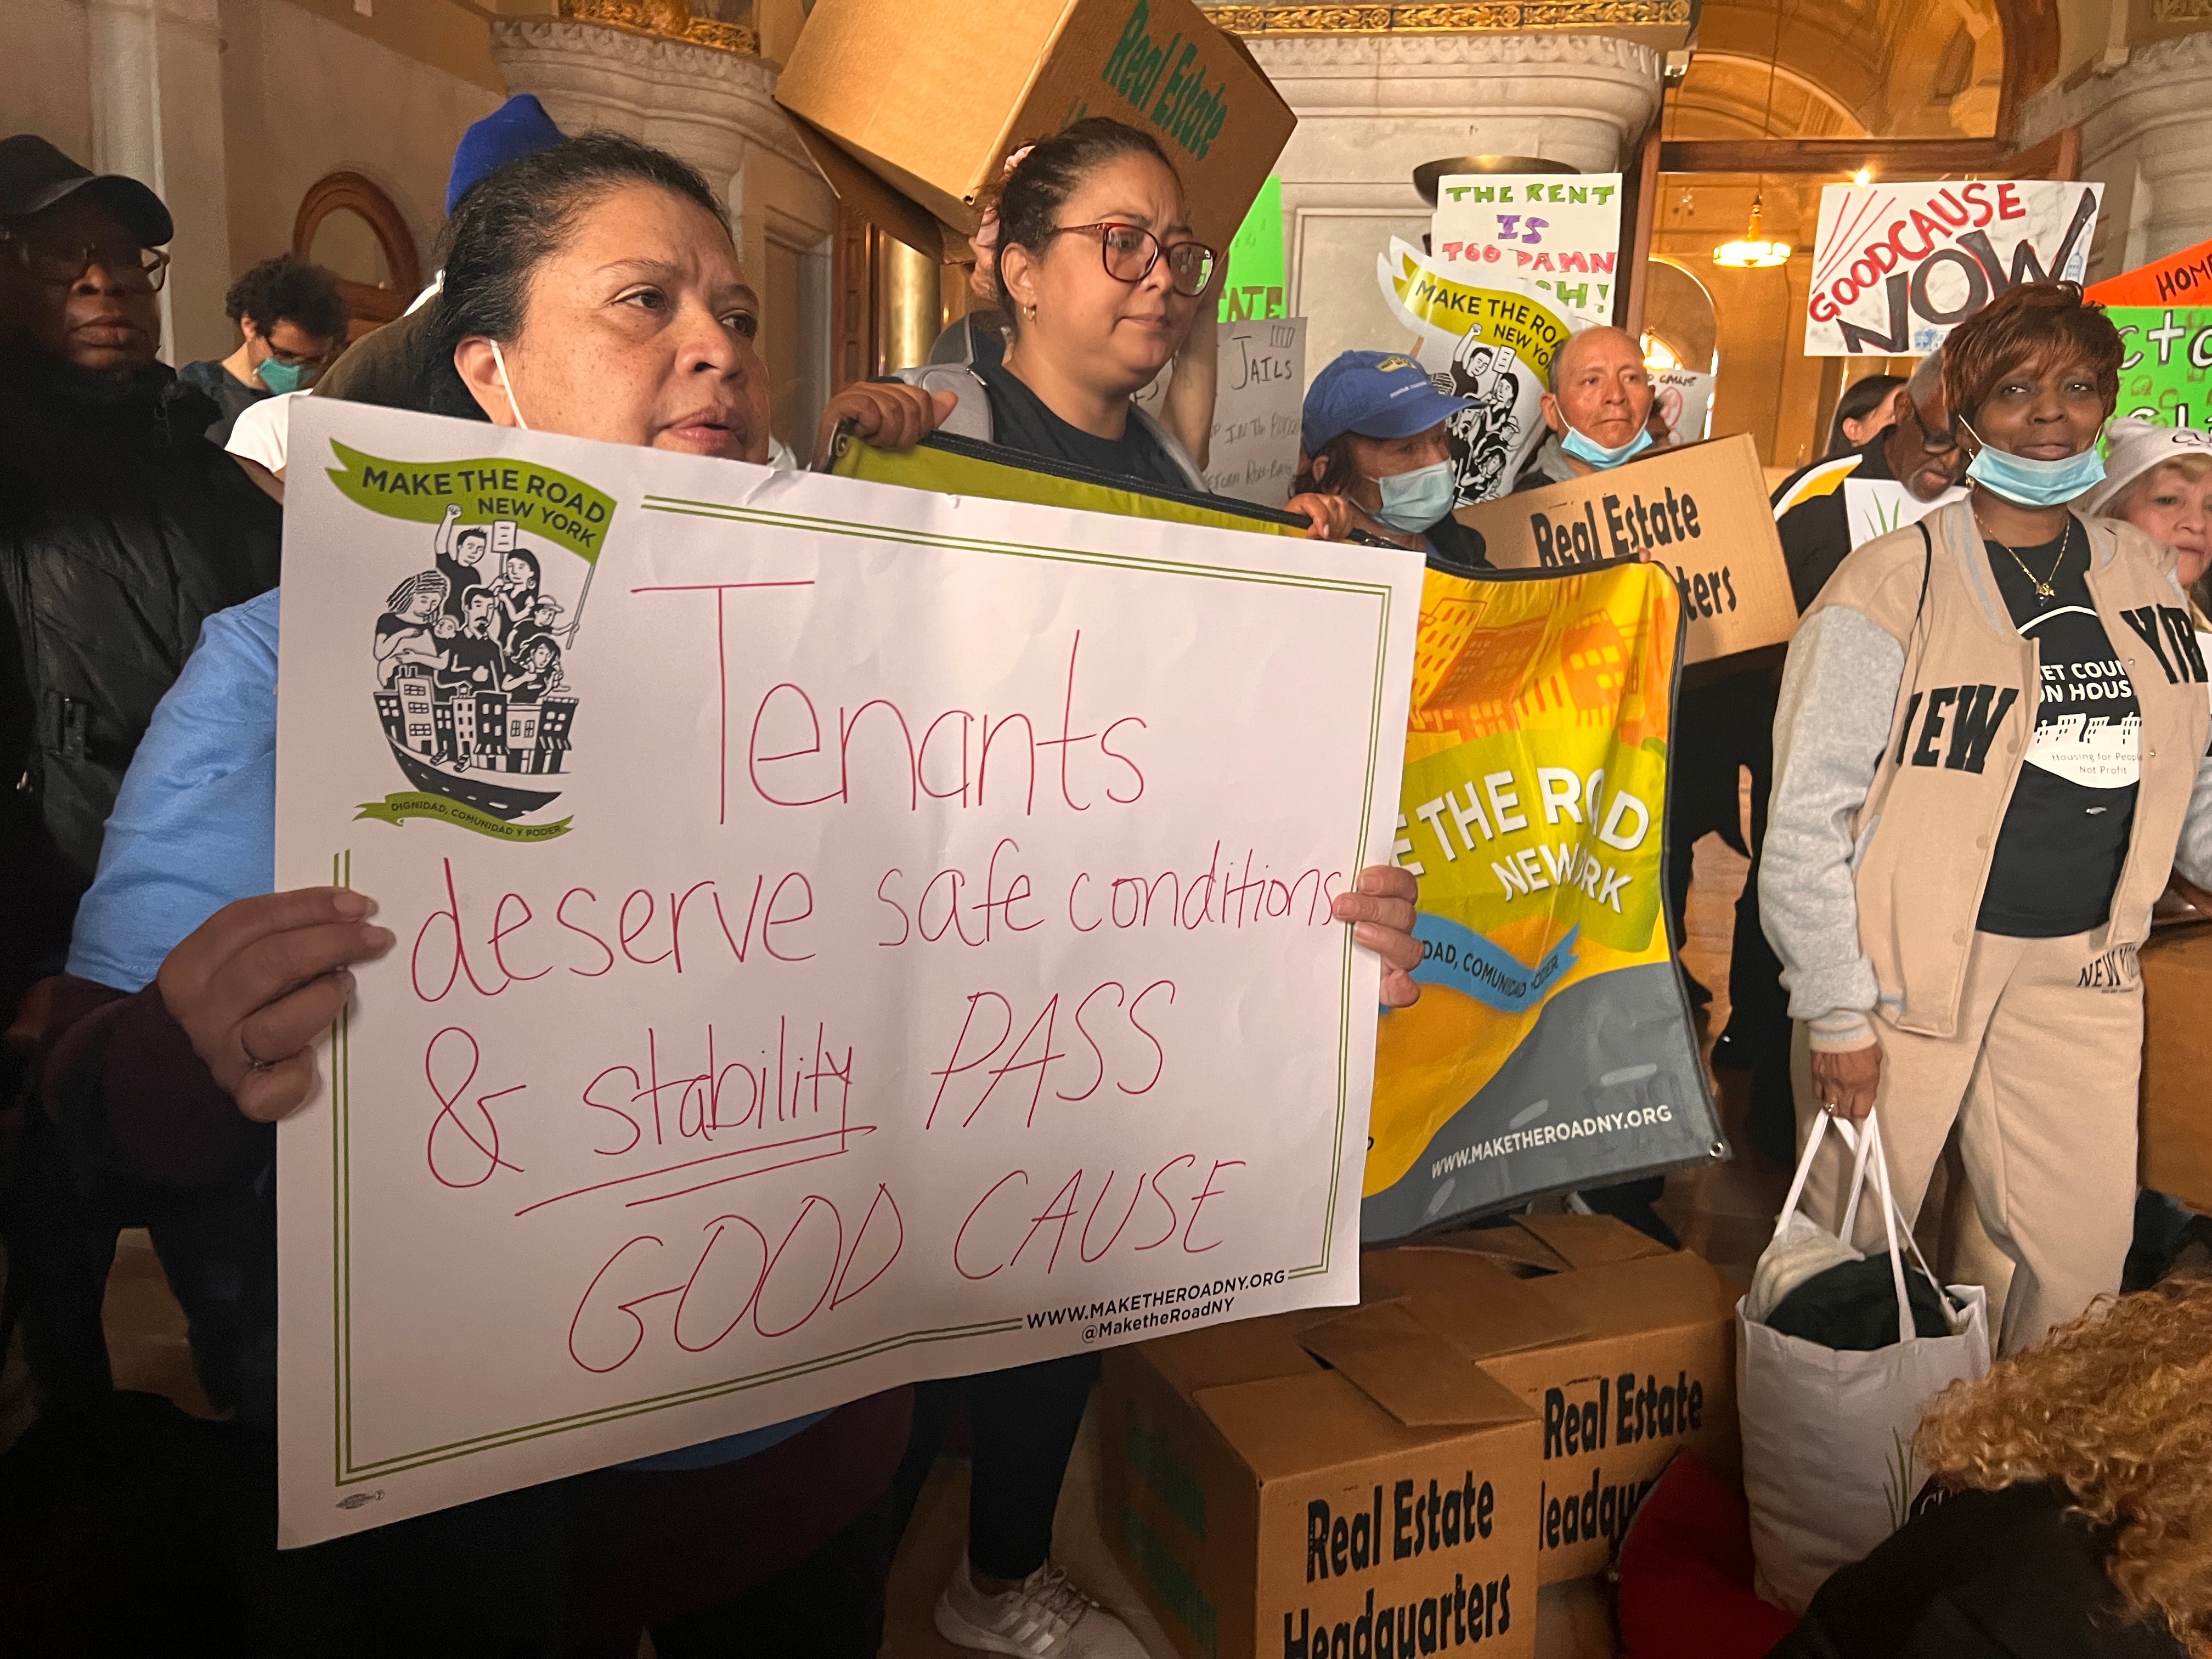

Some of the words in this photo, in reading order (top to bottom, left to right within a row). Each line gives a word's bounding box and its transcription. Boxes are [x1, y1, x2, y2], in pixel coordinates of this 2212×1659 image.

[1101, 0, 1183, 112] Real
[1150, 42, 1228, 161] Estate
[1446, 185, 1514, 204] THE
[1525, 183, 1615, 205] RENT
[1442, 241, 1501, 263] TOO
[1508, 248, 1617, 274] DAMN
[1496, 215, 1550, 245] IS
[1835, 188, 2097, 353] NOW
[1220, 286, 1283, 322] ATE
[1415, 280, 1481, 315] MAKE
[1487, 298, 1530, 324] THE
[1231, 336, 1293, 390] JAILS
[1493, 324, 1532, 349] NEW
[1532, 343, 1554, 371] YO
[362, 466, 454, 495] MAKE
[458, 469, 519, 493] THE
[526, 474, 605, 524] ROAD
[478, 498, 535, 518] NEW
[541, 507, 597, 548] YORK
[1530, 501, 1604, 567] Real
[1602, 487, 1701, 558] Estate
[2040, 664, 2066, 681] ET
[631, 580, 1147, 825] Tenants
[2051, 752, 2095, 762] Housing
[2097, 752, 2111, 761] for
[2079, 765, 2096, 774] Not
[2100, 765, 2127, 775] Profit
[391, 802, 448, 815] DIGNIDAD,
[451, 809, 514, 836] COMUNIDAD
[516, 828, 524, 837] Y
[526, 825, 561, 837] PODER
[1415, 770, 1528, 862] THE
[1491, 842, 1581, 902] NEW
[412, 857, 816, 1002] deserve
[878, 837, 1045, 946] safe
[1069, 839, 1342, 932] conditions
[2076, 947, 2121, 988] NEW
[425, 1026, 527, 1188] &
[583, 1014, 853, 1155] stability
[926, 980, 1175, 1130] PASS
[1432, 1104, 1673, 1179] WWW.MAKETHEROADNY.ORG
[569, 1183, 904, 1373] GOOD
[953, 1153, 1246, 1280] CAUSE
[1026, 1269, 1285, 1329] WWW.MAKETHEROADNY.ORG
[1081, 1297, 1235, 1344] @MaketheRoadNY
[1543, 1376, 1609, 1460] Real
[1616, 1370, 1703, 1446] Estate
[1307, 1485, 1383, 1584] Real
[1393, 1470, 1494, 1561] Estate
[1284, 1573, 1511, 1659] Headquarters
